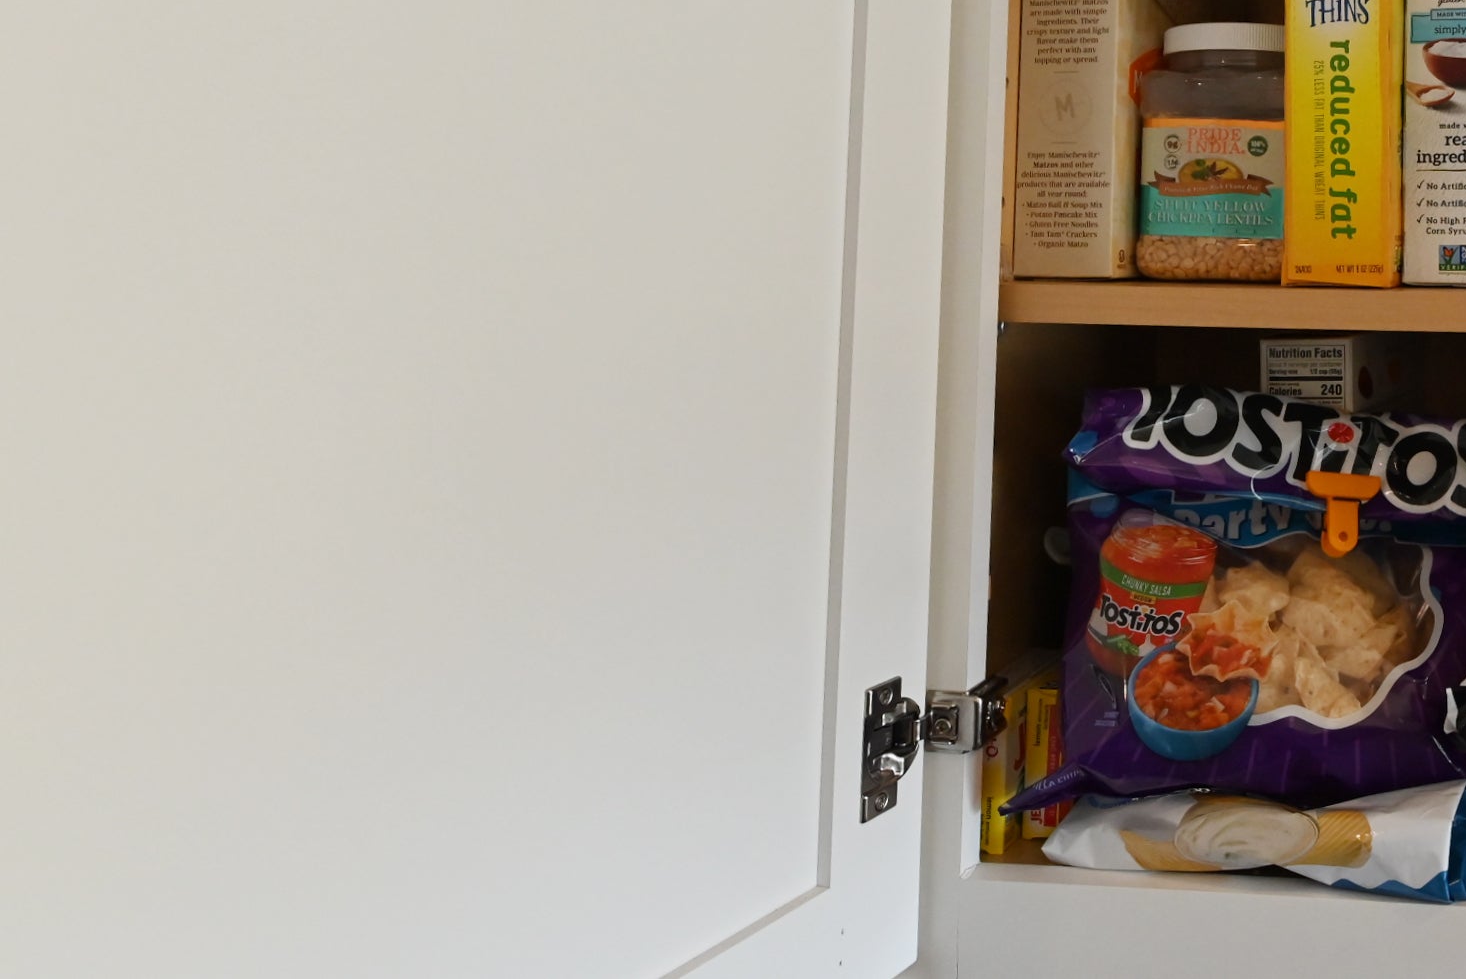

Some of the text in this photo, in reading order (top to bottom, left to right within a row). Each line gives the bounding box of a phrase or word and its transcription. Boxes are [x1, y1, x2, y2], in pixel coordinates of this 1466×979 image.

[1434, 24, 1466, 35] simply
[1187, 128, 1241, 141] PRIDE
[1328, 39, 1358, 239] reduced fat
[1156, 199, 1266, 213] SPLIT YELLOW
[1217, 213, 1273, 225] LENTILS
[1440, 217, 1460, 226] High
[1426, 227, 1446, 235] Corn
[1269, 347, 1342, 358] Nutrition Facts
[1269, 387, 1302, 396] Calories
[1321, 384, 1342, 395] 240
[1121, 575, 1172, 596] CHUNKY SALSA
